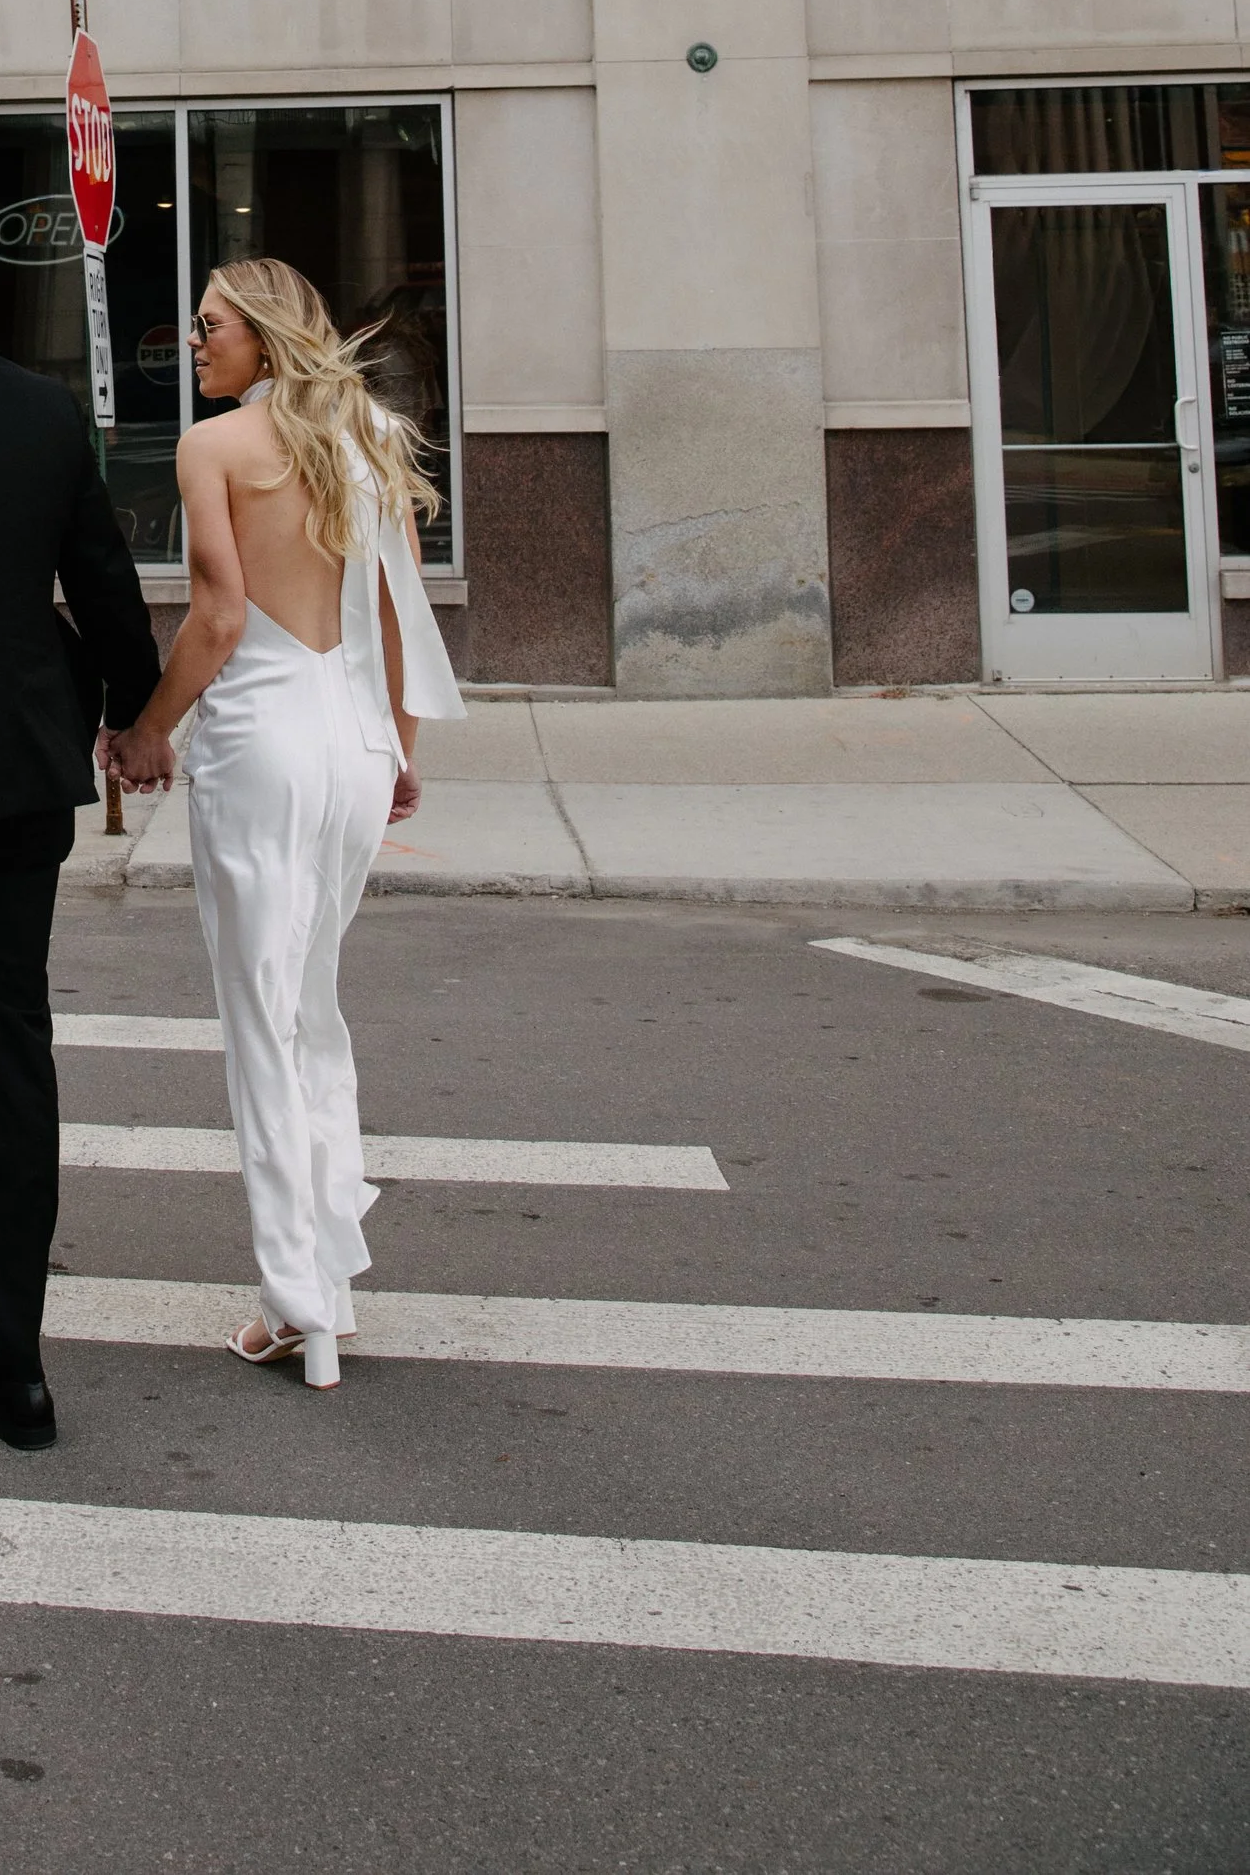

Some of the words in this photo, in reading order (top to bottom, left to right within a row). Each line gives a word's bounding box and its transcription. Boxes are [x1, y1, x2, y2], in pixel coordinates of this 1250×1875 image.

[71, 93, 112, 183] STOP
[89, 272, 106, 305] RIGHT
[92, 308, 108, 339] TURN
[95, 345, 109, 375] ONLY
[140, 348, 179, 362] PEP
